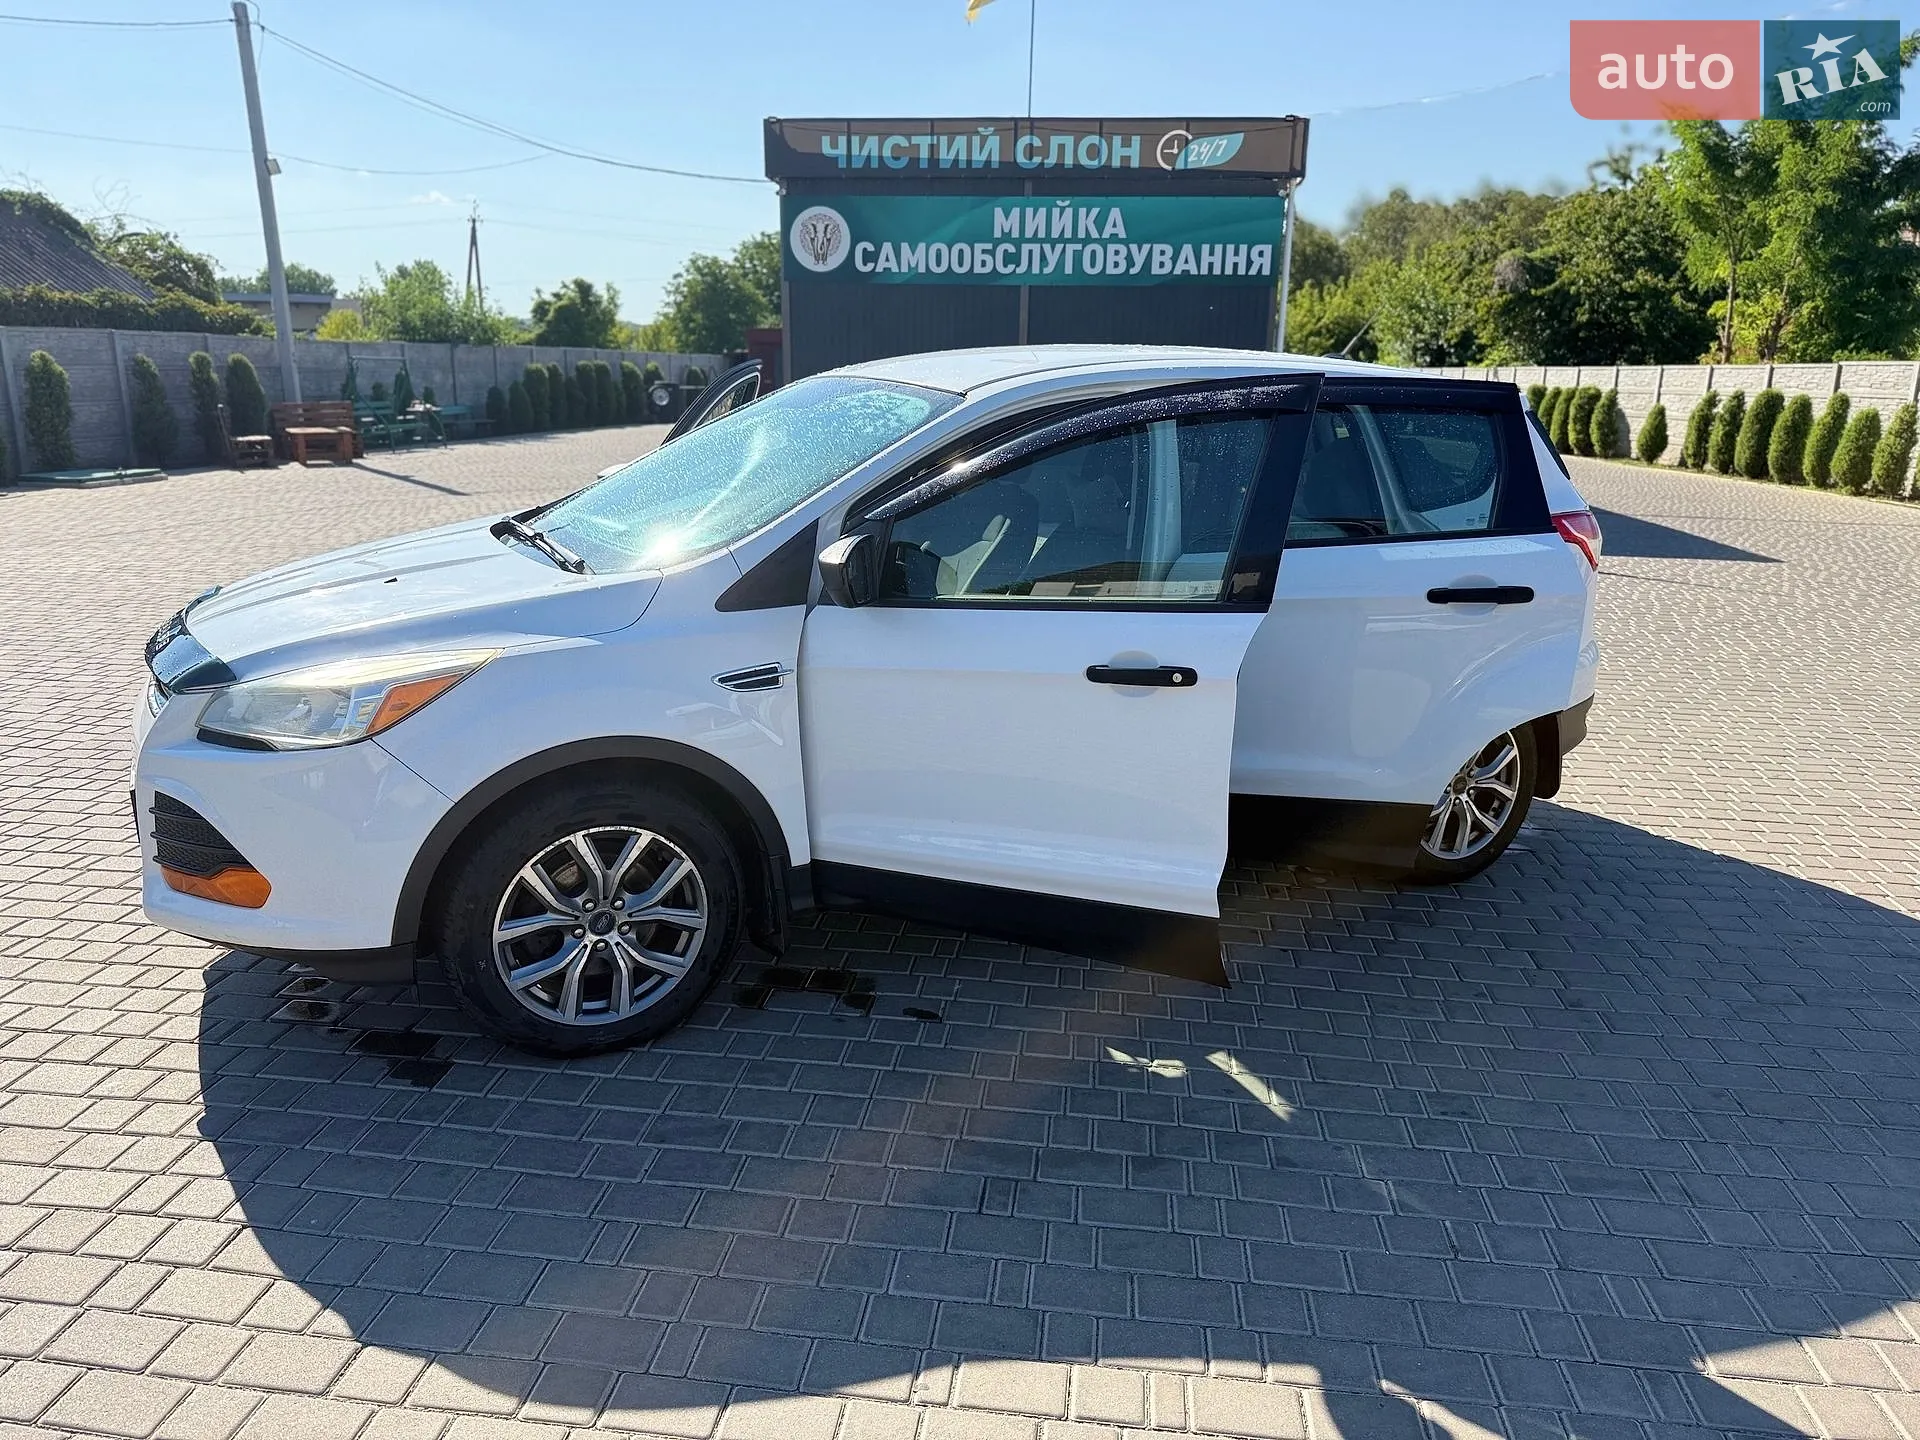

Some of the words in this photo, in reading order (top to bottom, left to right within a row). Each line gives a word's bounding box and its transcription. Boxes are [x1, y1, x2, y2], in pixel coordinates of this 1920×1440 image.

[821, 127, 999, 169] ЧИСТИЙ
[1015, 133, 1141, 169] СЛОН
[1187, 137, 1229, 165] 24/7
[993, 200, 1127, 239] МИЙКА
[854, 241, 1272, 277] САМООБСЛУГОВУВАННЯ
